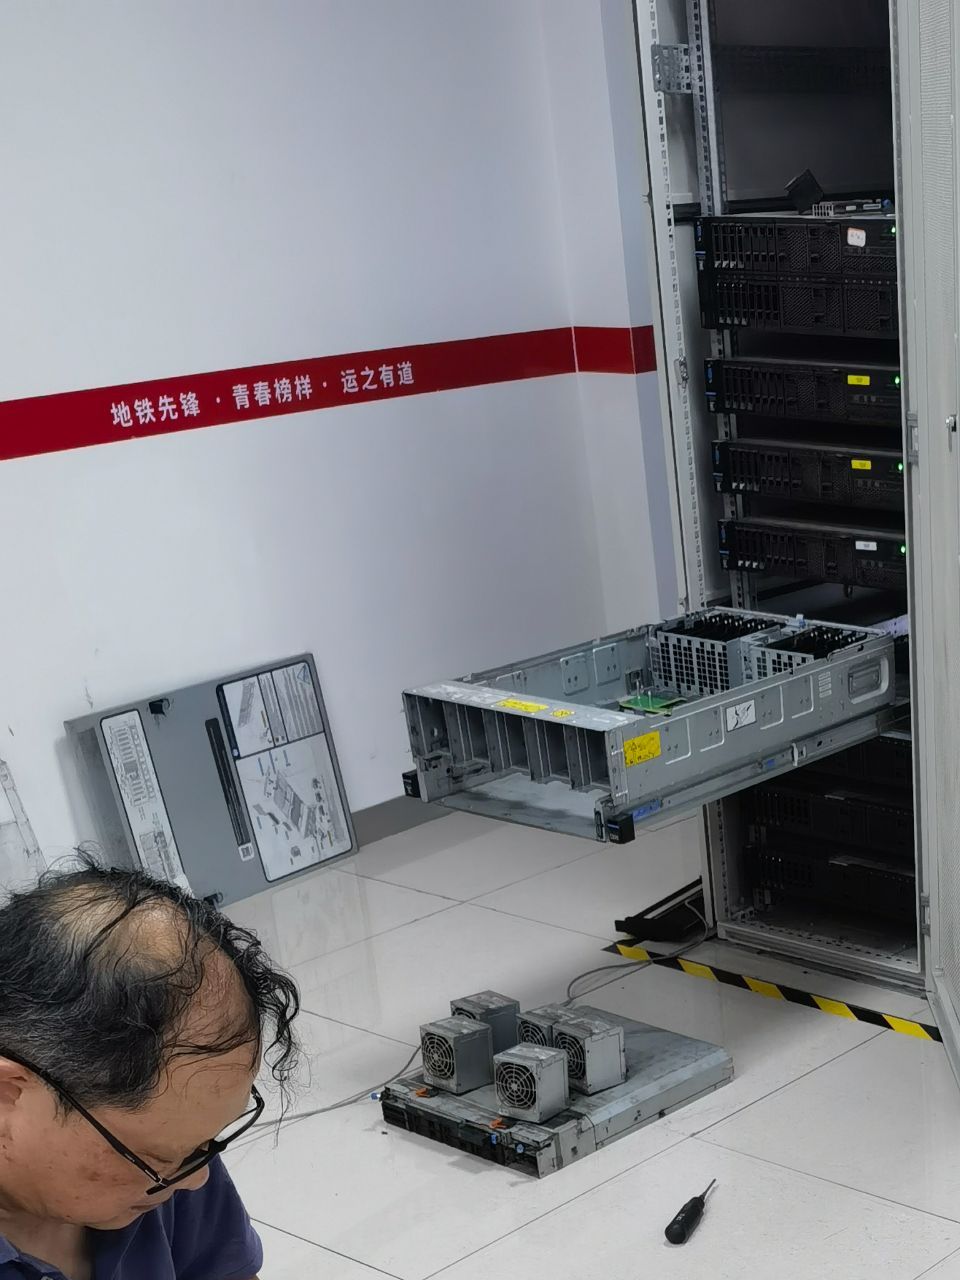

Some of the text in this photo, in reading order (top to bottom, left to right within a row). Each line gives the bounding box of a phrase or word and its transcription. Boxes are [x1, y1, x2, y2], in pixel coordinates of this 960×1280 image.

[110, 361, 414, 428] 地铁先锋 青春榜样 运之有道
